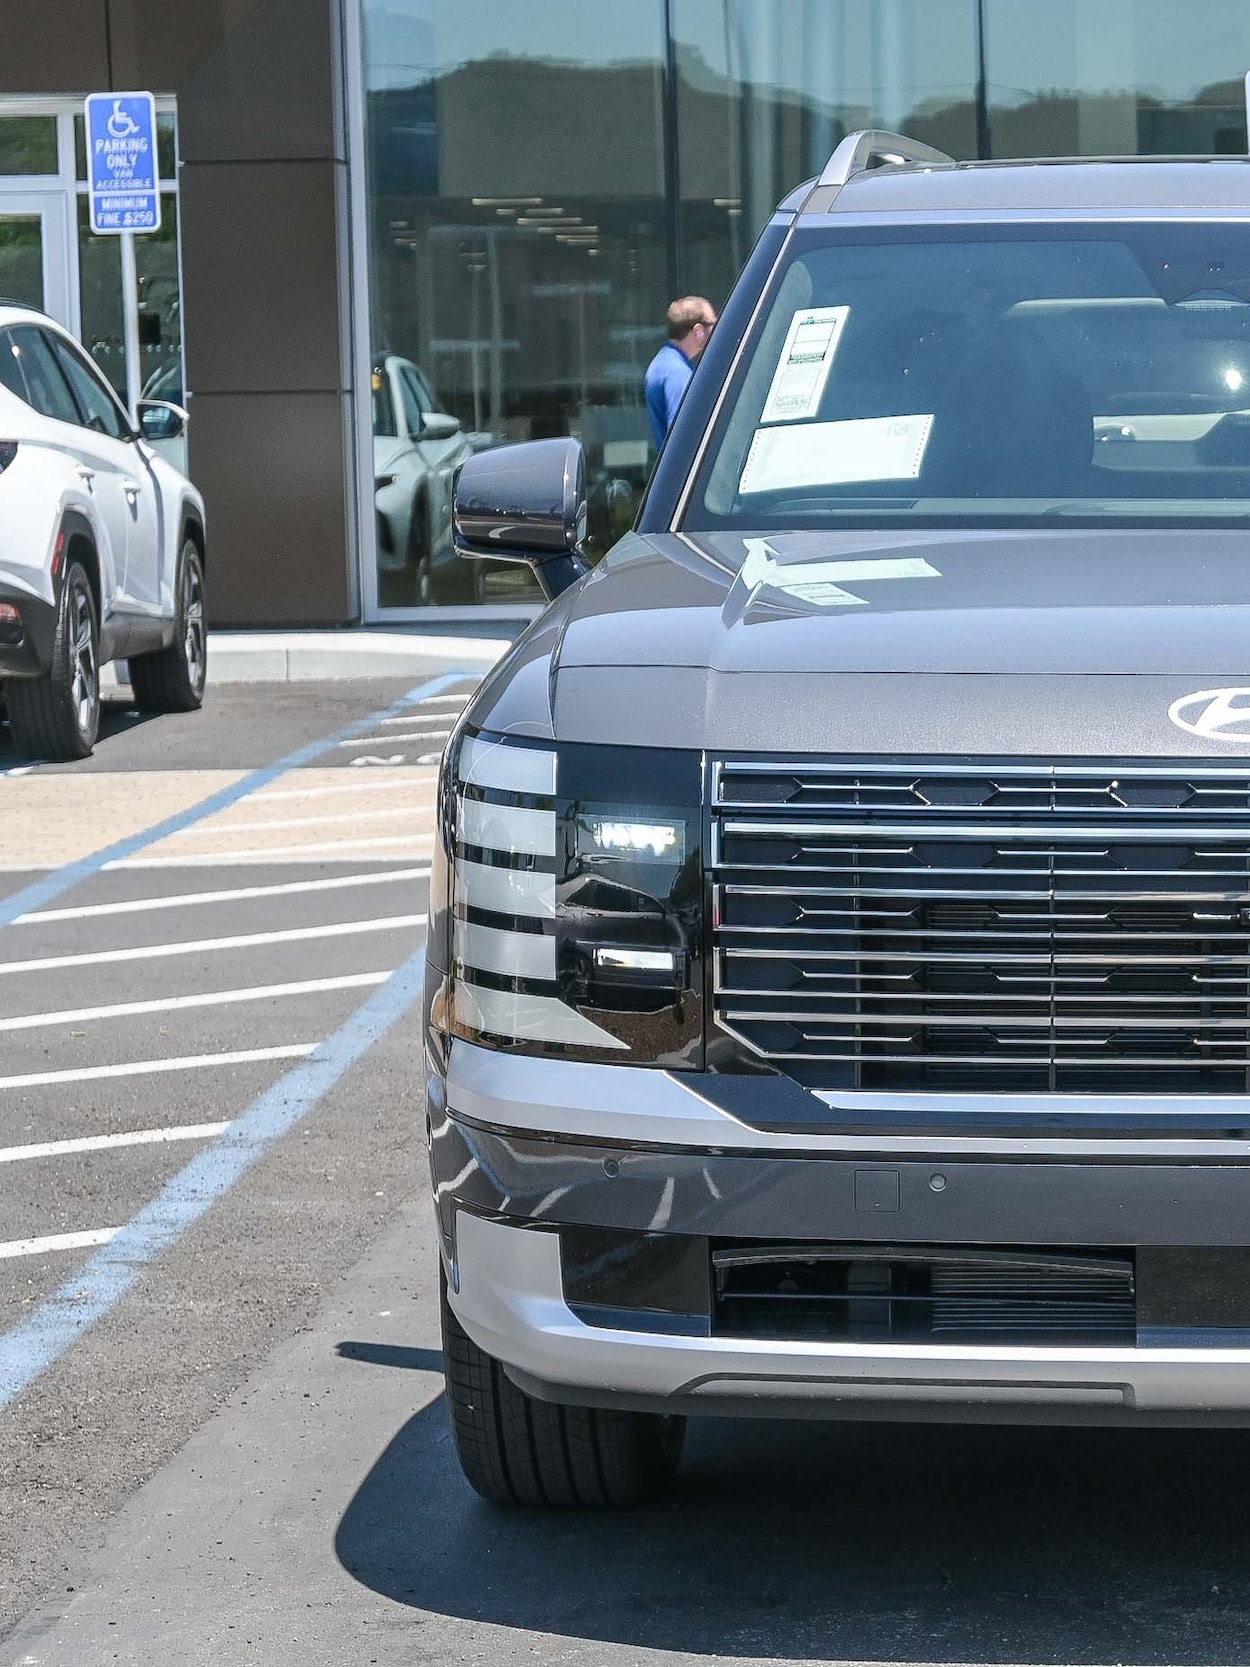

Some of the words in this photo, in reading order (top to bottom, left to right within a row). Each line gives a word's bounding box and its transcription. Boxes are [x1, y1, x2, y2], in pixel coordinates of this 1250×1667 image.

[95, 137, 149, 154] PARKING
[106, 154, 138, 169] ONLY
[96, 178, 153, 190] ACCESSIBLE
[101, 196, 149, 210] MINIMUM
[97, 212, 121, 226] FINE
[123, 210, 154, 226] $250
